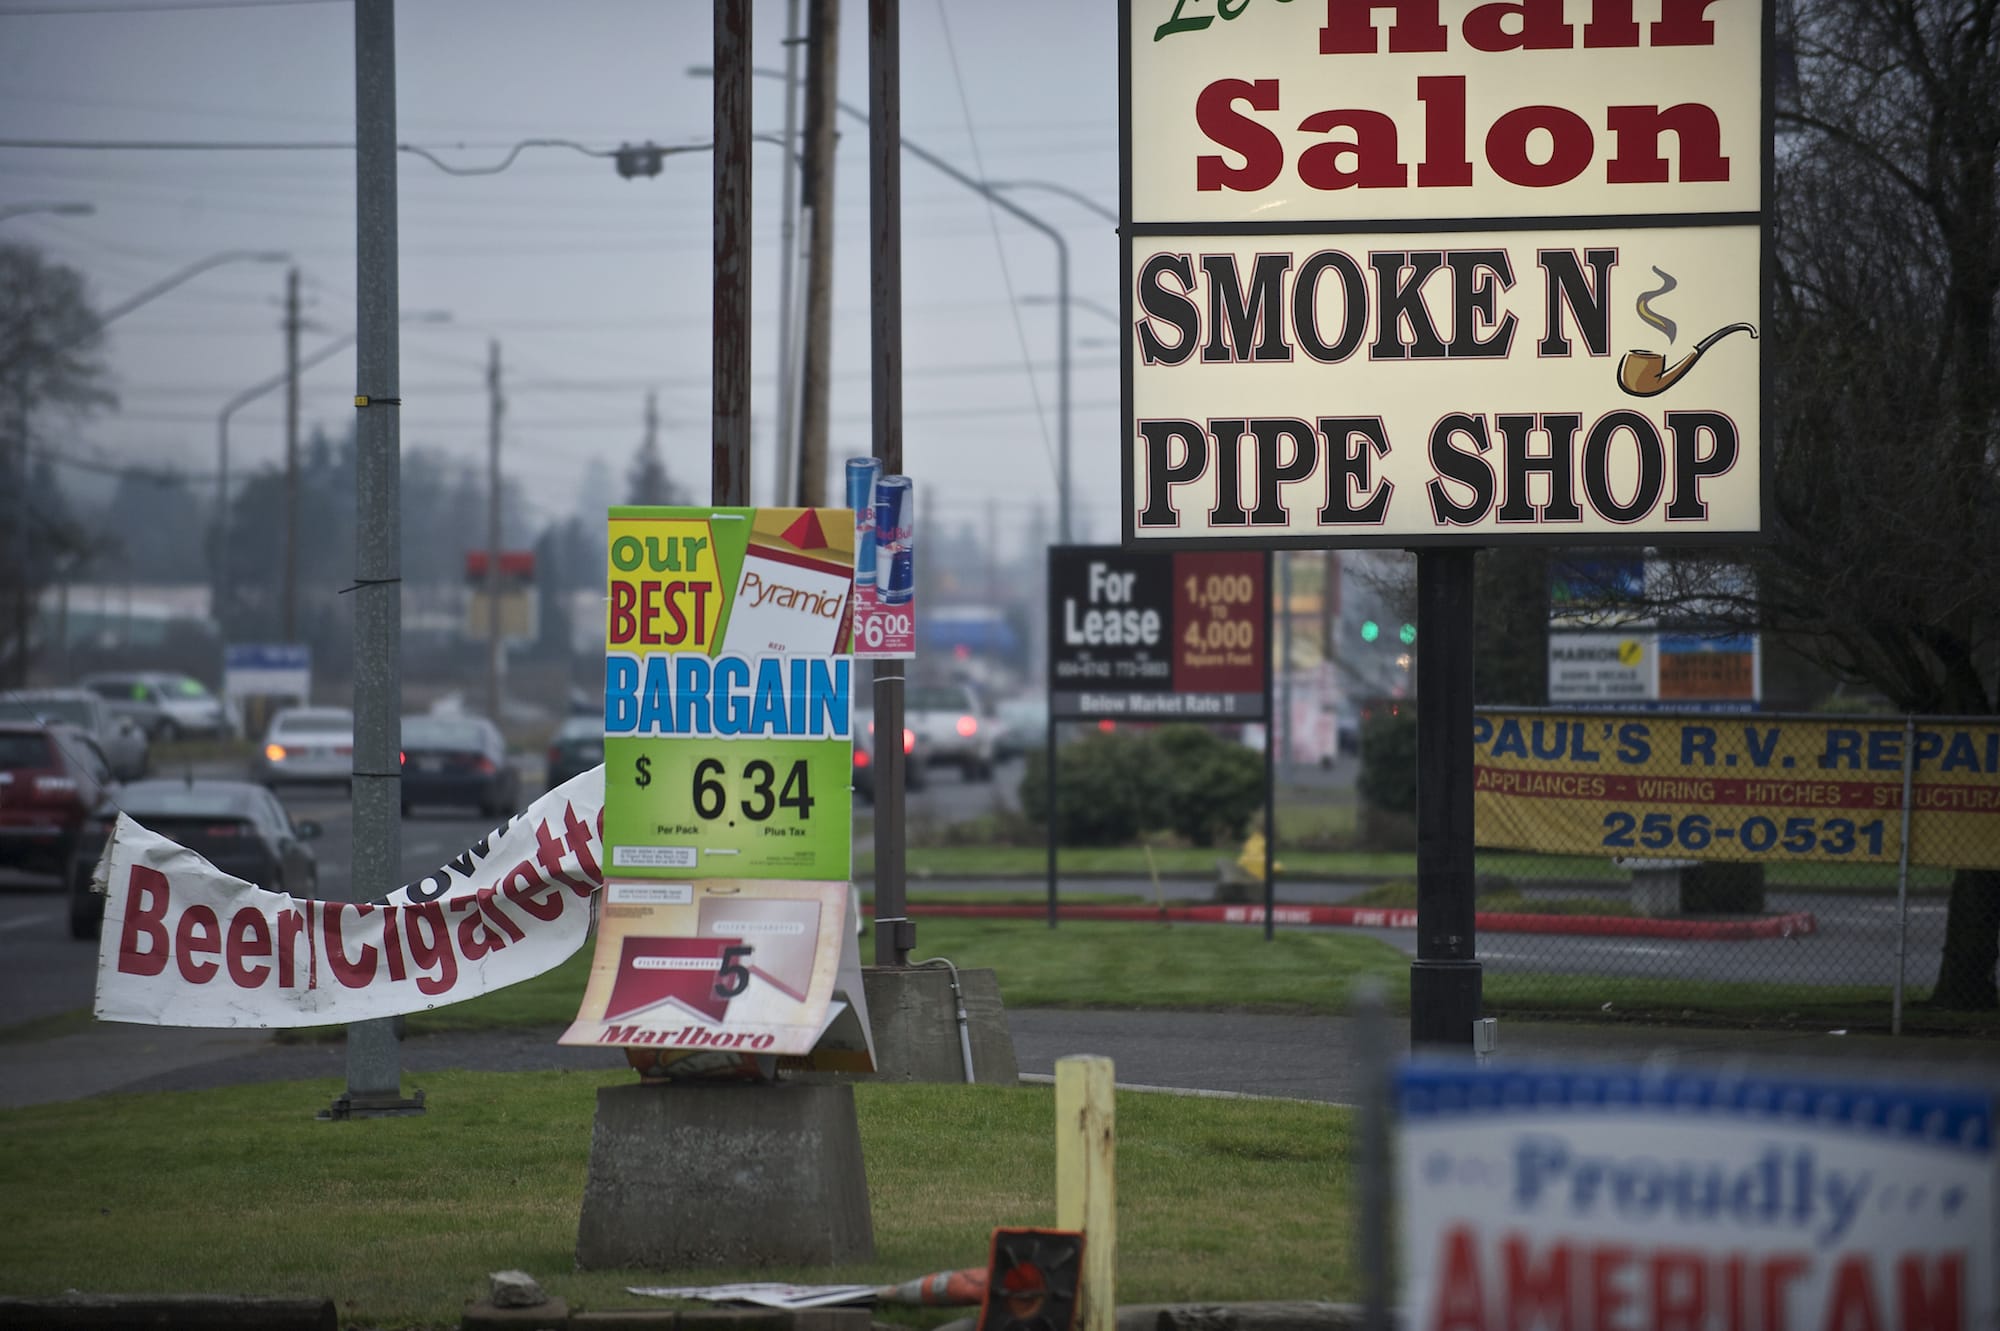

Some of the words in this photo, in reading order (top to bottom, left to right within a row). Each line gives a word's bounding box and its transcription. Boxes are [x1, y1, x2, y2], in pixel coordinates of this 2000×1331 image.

[1196, 75, 1730, 191] Salon
[1135, 248, 1518, 366] SMOKE
[1537, 247, 1619, 358] N
[1137, 415, 1395, 528] PIPE
[1426, 409, 1739, 526] SHOP
[611, 535, 707, 572] our
[739, 571, 843, 619] Pyramid
[1089, 562, 1136, 603] For
[1185, 574, 1253, 608] 1,000
[610, 581, 712, 645] BEST
[1066, 598, 1160, 645] Lease
[1184, 620, 1253, 654] 4,000
[605, 656, 850, 735] BARGAIN
[1080, 694, 1126, 713] Below
[1129, 694, 1182, 713] Market
[1186, 694, 1221, 713] Rate
[1474, 717, 1651, 764] PAUL'S
[1680, 726, 1796, 769] R.V.
[1825, 729, 1999, 773] REPAI
[692, 757, 816, 828] 6.34
[1477, 770, 1606, 796] APPLIANCES
[1637, 780, 1715, 801] WIRING
[1746, 782, 1841, 804] HITCHES
[1873, 786, 2000, 809] STUCTUR
[657, 825, 673, 835] Per
[676, 825, 699, 835] Pack
[764, 827, 786, 837] Plus
[789, 827, 806, 837] Tax
[1602, 811, 1885, 856] 256-0531
[118, 864, 304, 989] Beer
[323, 800, 604, 996] Cigarett
[1353, 911, 1386, 926] FIRE
[1390, 912, 1418, 927] LAN
[715, 945, 755, 997] 5
[597, 1025, 775, 1049] Marlboro
[1508, 1130, 1869, 1248] Proudly
[1428, 1222, 1967, 1331] AMERICAN
